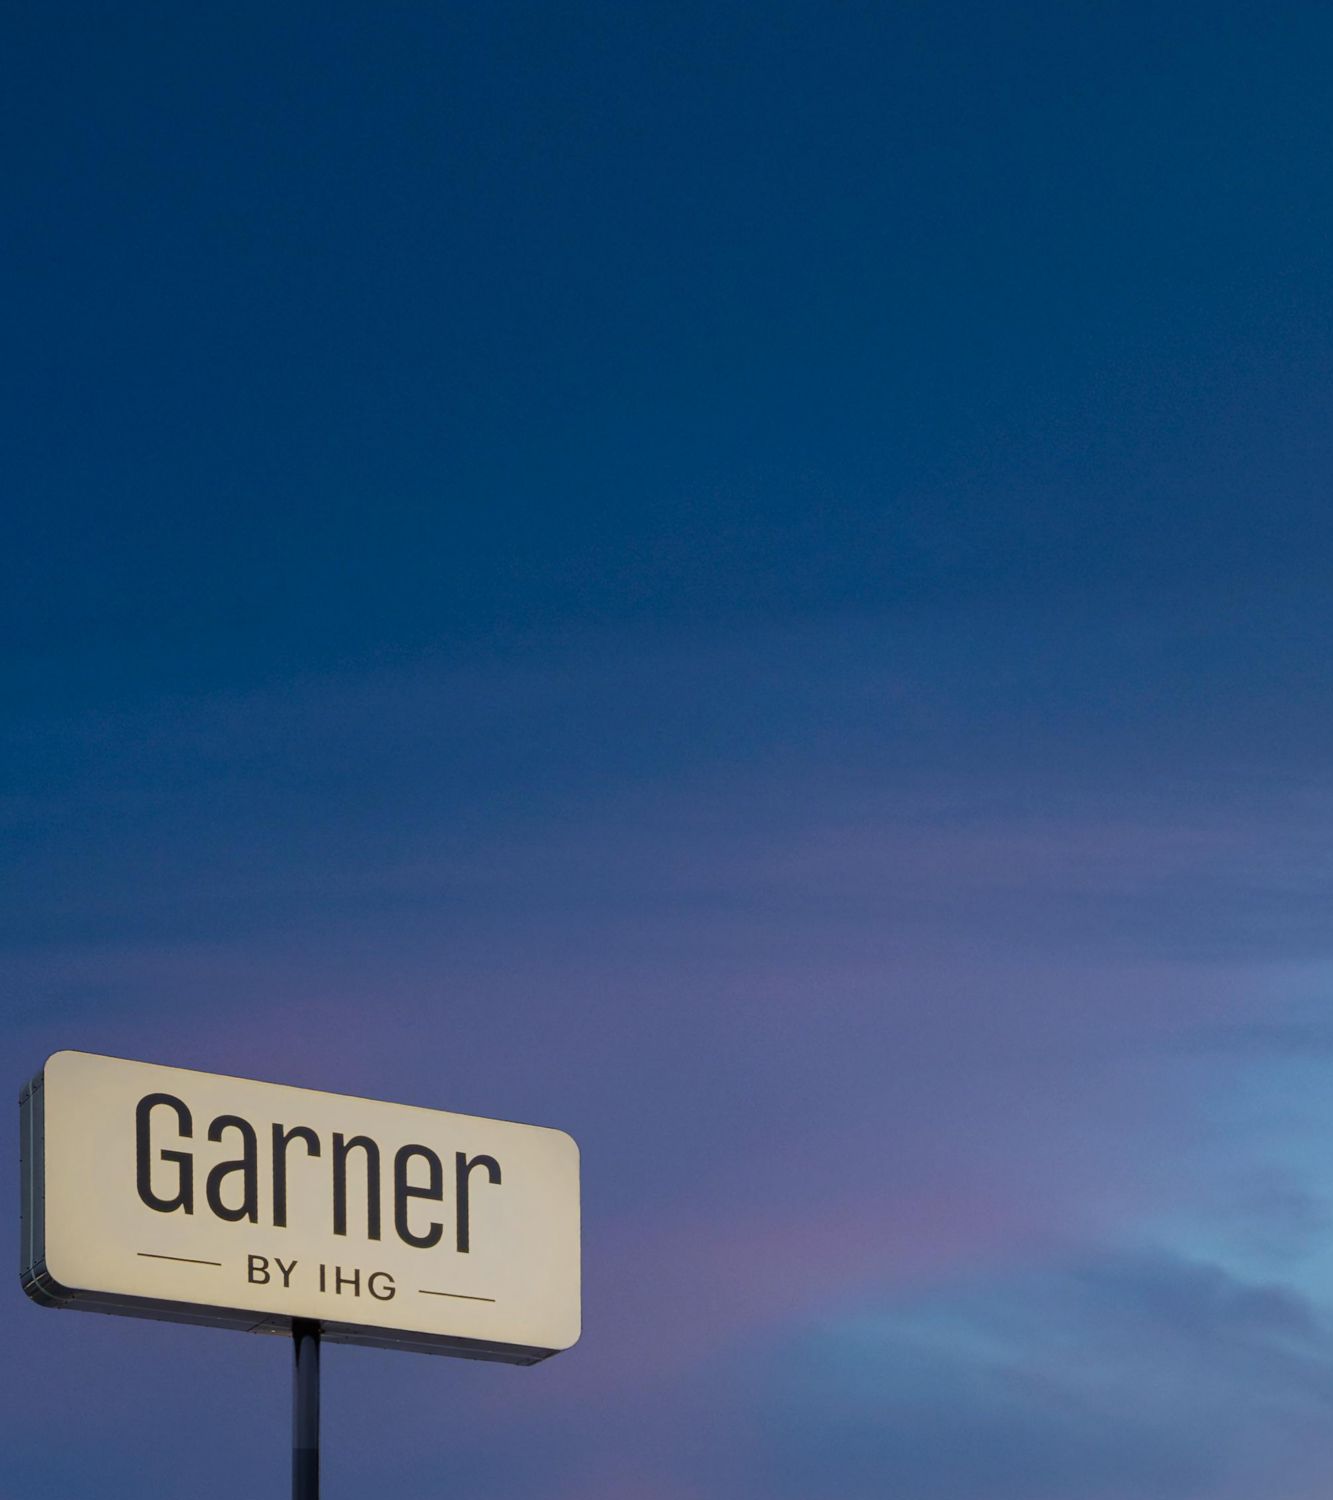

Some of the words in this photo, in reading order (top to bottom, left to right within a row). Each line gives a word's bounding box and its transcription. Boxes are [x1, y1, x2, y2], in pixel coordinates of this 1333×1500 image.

[136, 1093, 502, 1253] Garner
[247, 1254, 298, 1288] BY
[319, 1264, 396, 1301] IHG
